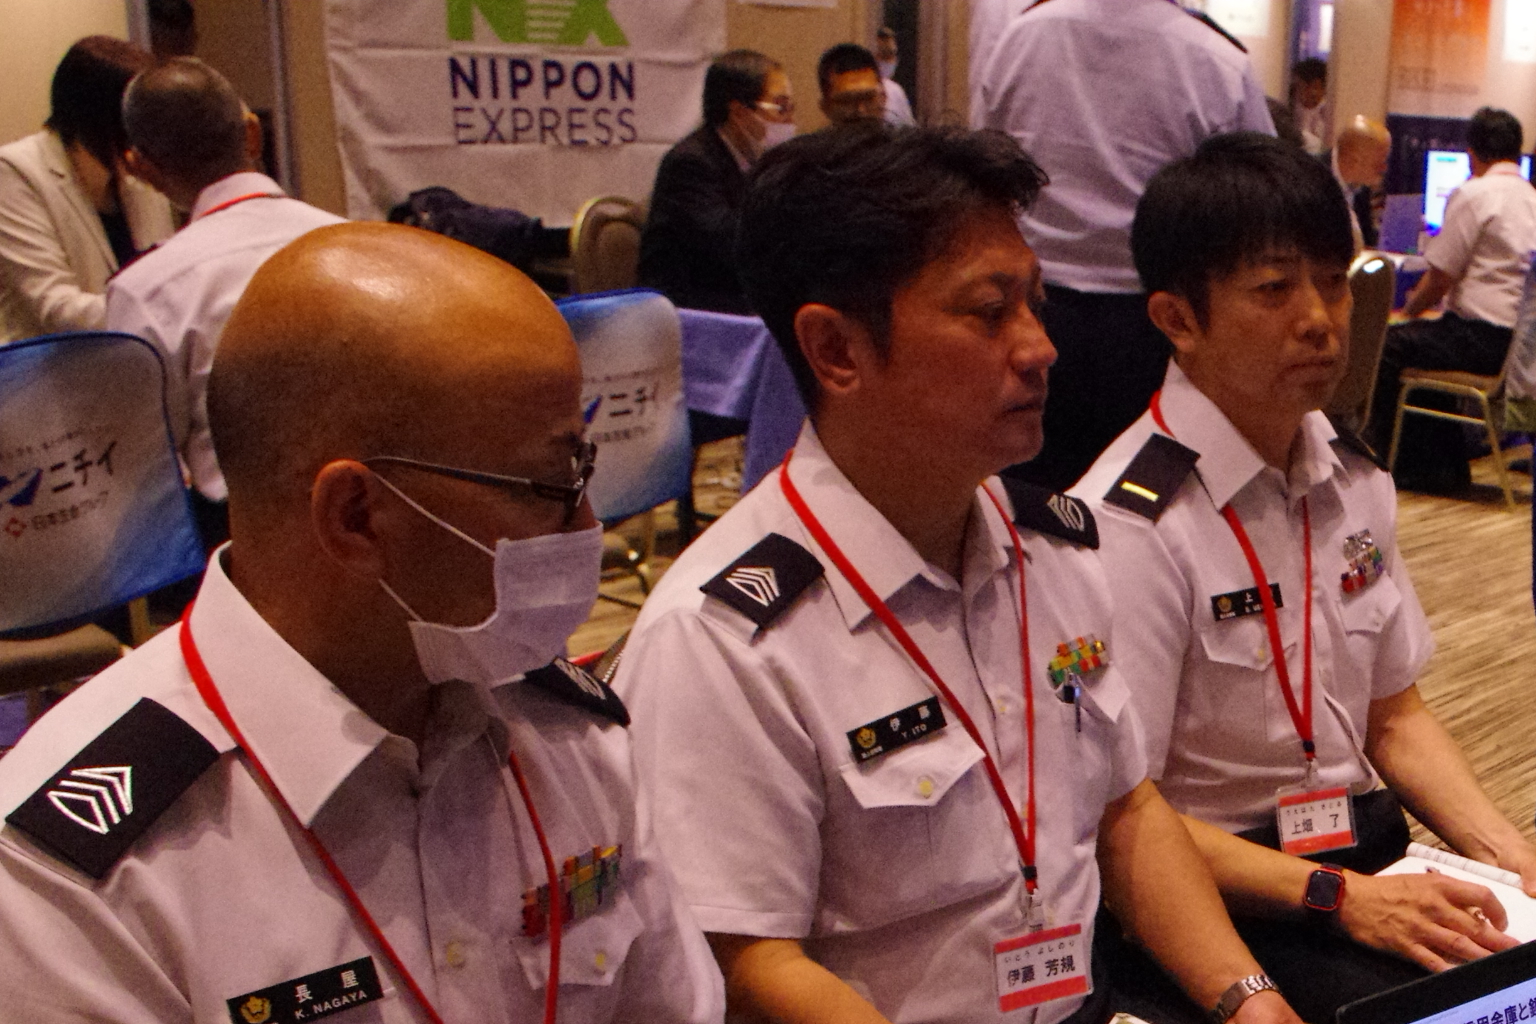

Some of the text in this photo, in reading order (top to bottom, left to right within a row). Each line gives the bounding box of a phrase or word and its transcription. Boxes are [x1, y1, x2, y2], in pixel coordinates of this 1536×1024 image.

[448, 56, 635, 101] NIPPON
[453, 106, 638, 146] EXPRESS
[50, 440, 118, 494] ニチイ
[312, 989, 368, 1014] NAGAYA
